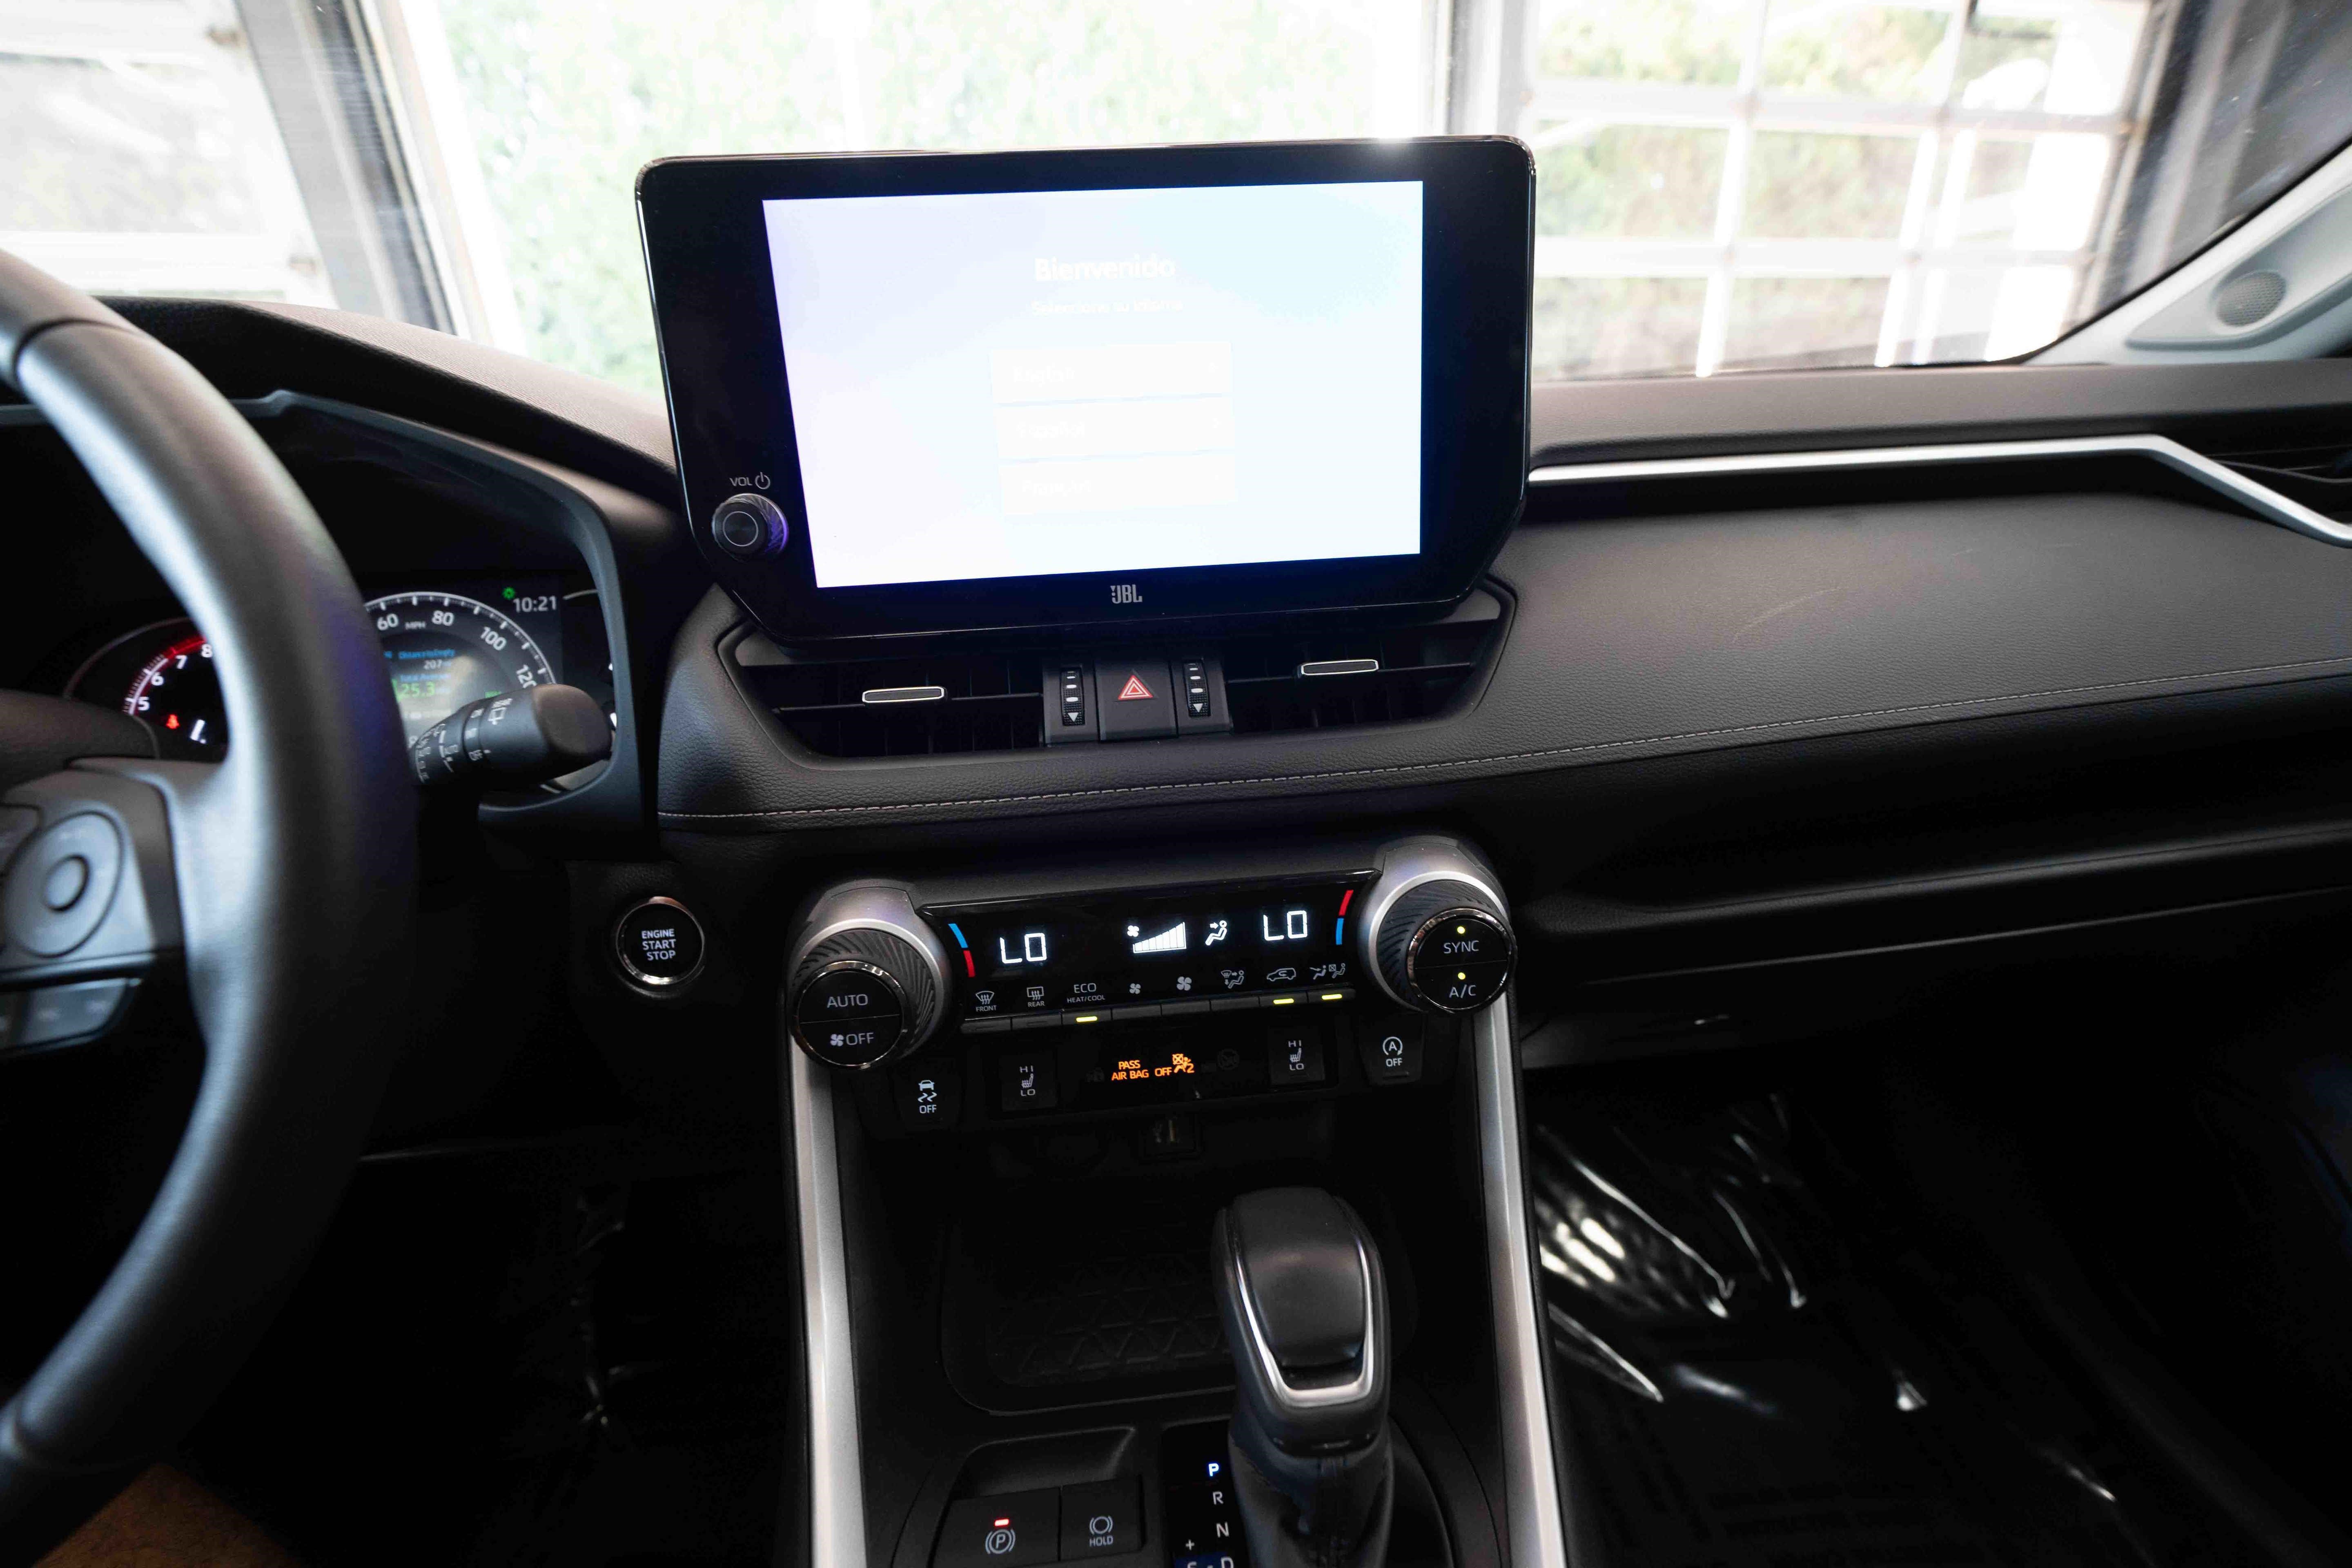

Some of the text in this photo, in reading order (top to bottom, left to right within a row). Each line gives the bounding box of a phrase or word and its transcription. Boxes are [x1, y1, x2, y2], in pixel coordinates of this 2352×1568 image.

[1034, 252, 1176, 281] Bienvenido
[729, 477, 753, 486] VOL
[1110, 584, 1143, 604] JBL
[512, 595, 557, 613] 10:21
[376, 613, 399, 631] 60
[432, 610, 455, 626] 80
[480, 626, 507, 651] 100
[201, 643, 213, 659] 8
[175, 655, 187, 670] 7
[150, 673, 164, 686] 6
[399, 681, 436, 697] 25.3
[136, 697, 151, 712] 5
[1263, 910, 1307, 941] LO
[641, 928, 675, 939] ENGINE
[642, 939, 676, 950] START
[1000, 933, 1047, 964] LO
[1443, 940, 1479, 953] SYNC
[646, 950, 676, 961] STOP
[1074, 983, 1097, 994] ECO
[1449, 984, 1477, 998] A/C
[827, 994, 868, 1008] AUTO
[1067, 995, 1105, 1003] HEAT/COOL
[846, 1032, 874, 1045] OFF
[1118, 1060, 1141, 1070] PASS
[1386, 1058, 1403, 1067] OFF
[1111, 1067, 1172, 1081] AIR BAG OFF
[1020, 1089, 1036, 1097] LO
[919, 1105, 937, 1114] OFF
[1208, 1463, 1220, 1477] P
[1212, 1491, 1224, 1505] R
[1216, 1521, 1229, 1538] N
[1089, 1535, 1114, 1547] HOLD
